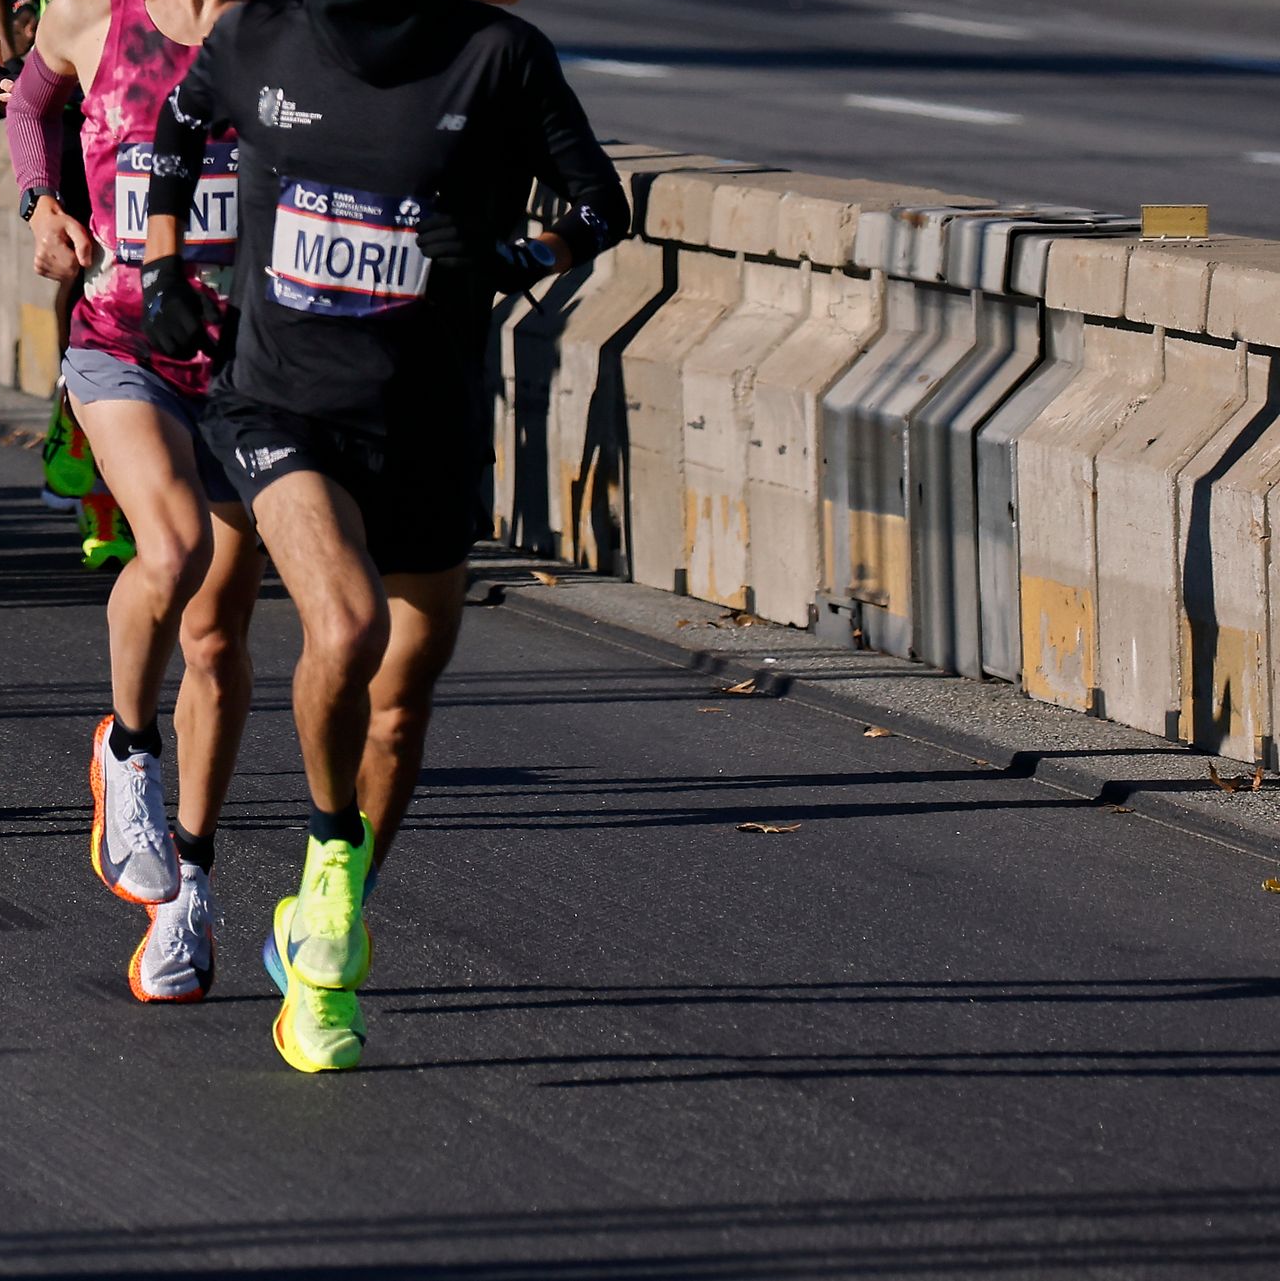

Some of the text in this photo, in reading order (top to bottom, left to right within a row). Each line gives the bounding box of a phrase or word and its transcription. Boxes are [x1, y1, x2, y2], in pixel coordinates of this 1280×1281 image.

[131, 147, 152, 171] tc
[127, 190, 234, 232] MNT
[294, 184, 328, 214] tcs
[332, 200, 384, 216] CONSULTANCY
[333, 192, 355, 203] TATA
[294, 229, 409, 286] MORII
